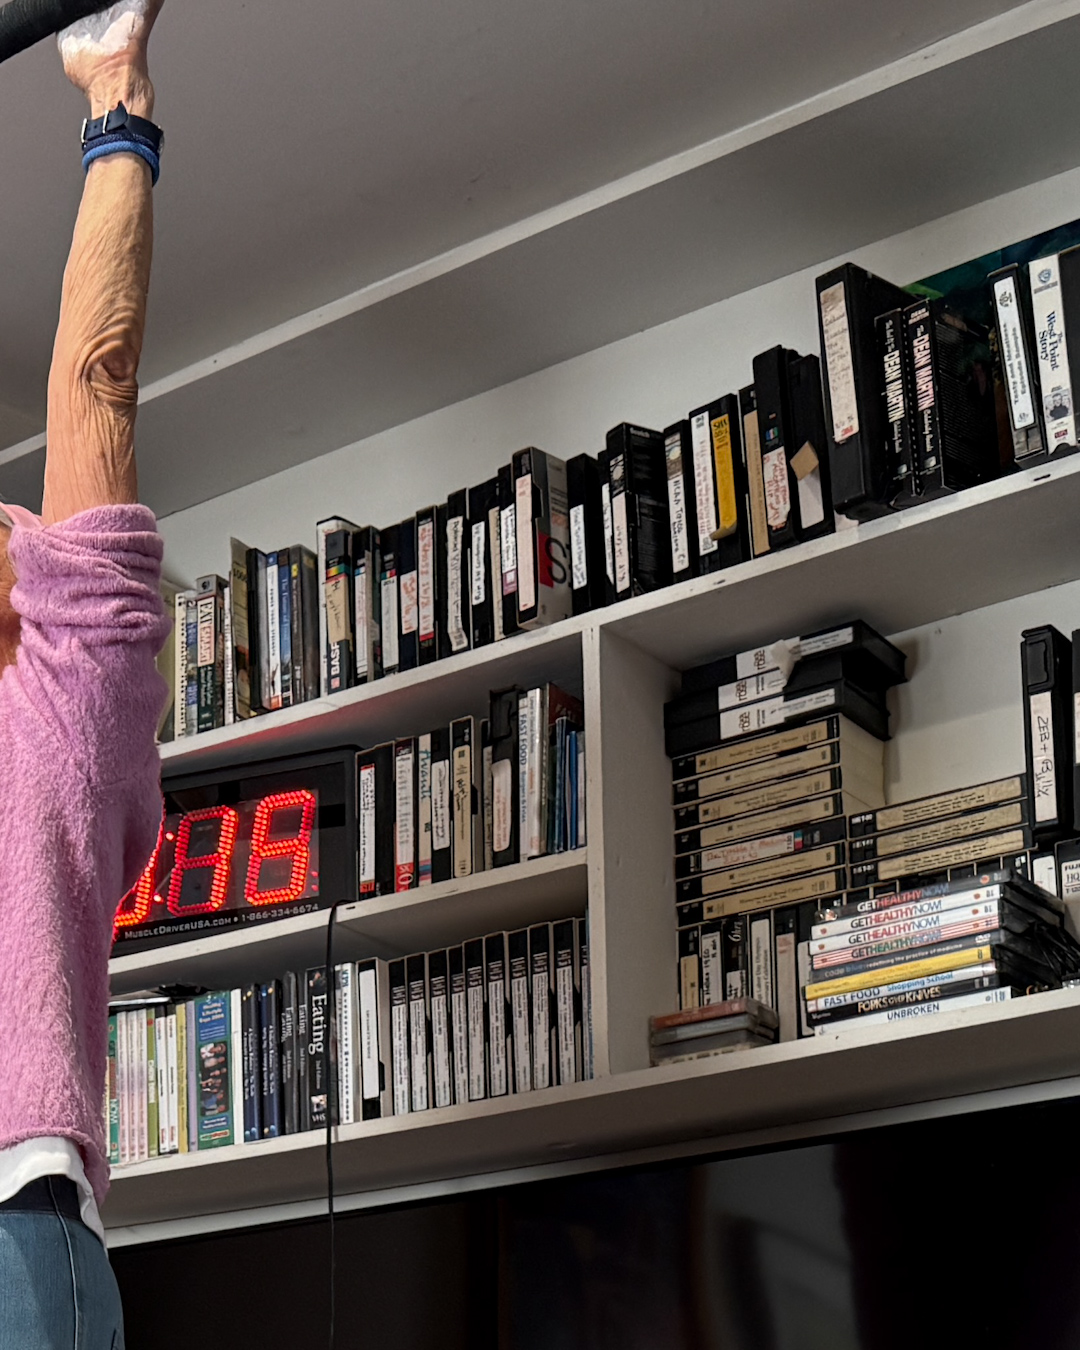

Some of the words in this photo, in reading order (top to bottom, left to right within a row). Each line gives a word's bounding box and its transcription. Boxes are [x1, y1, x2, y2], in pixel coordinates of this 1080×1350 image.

[1047, 311, 1056, 339] West
[912, 334, 931, 368] DEAN
[1038, 330, 1049, 362] Story
[1048, 341, 1059, 371] Point
[884, 350, 901, 382] DEAN
[887, 380, 905, 423] MARTIN
[915, 366, 935, 411] MARTIN
[200, 601, 212, 624] EAT
[200, 626, 211, 663] SMART
[1038, 716, 1050, 742] ZEB
[857, 883, 949, 912] GETHEALTHYNOW!
[241, 903, 319, 923] 1-866-334-6674
[850, 900, 942, 929] GETHEALTHYNOW!
[848, 915, 940, 944] GETHEALTHYNOW!
[851, 929, 942, 958] GETHEALTHYNOW!
[825, 966, 844, 977] code
[906, 949, 929, 961] practice
[937, 943, 962, 953] medicine
[824, 995, 847, 1007] FAST
[851, 987, 880, 999] FOOD
[887, 979, 926, 992] Shopping
[926, 972, 954, 984] School
[906, 986, 941, 1003] KNIVES
[285, 1006, 294, 1037] Eating
[298, 1004, 307, 1035] Eating
[308, 993, 327, 1055] Eating
[887, 1003, 940, 1021] UNBROKEN
